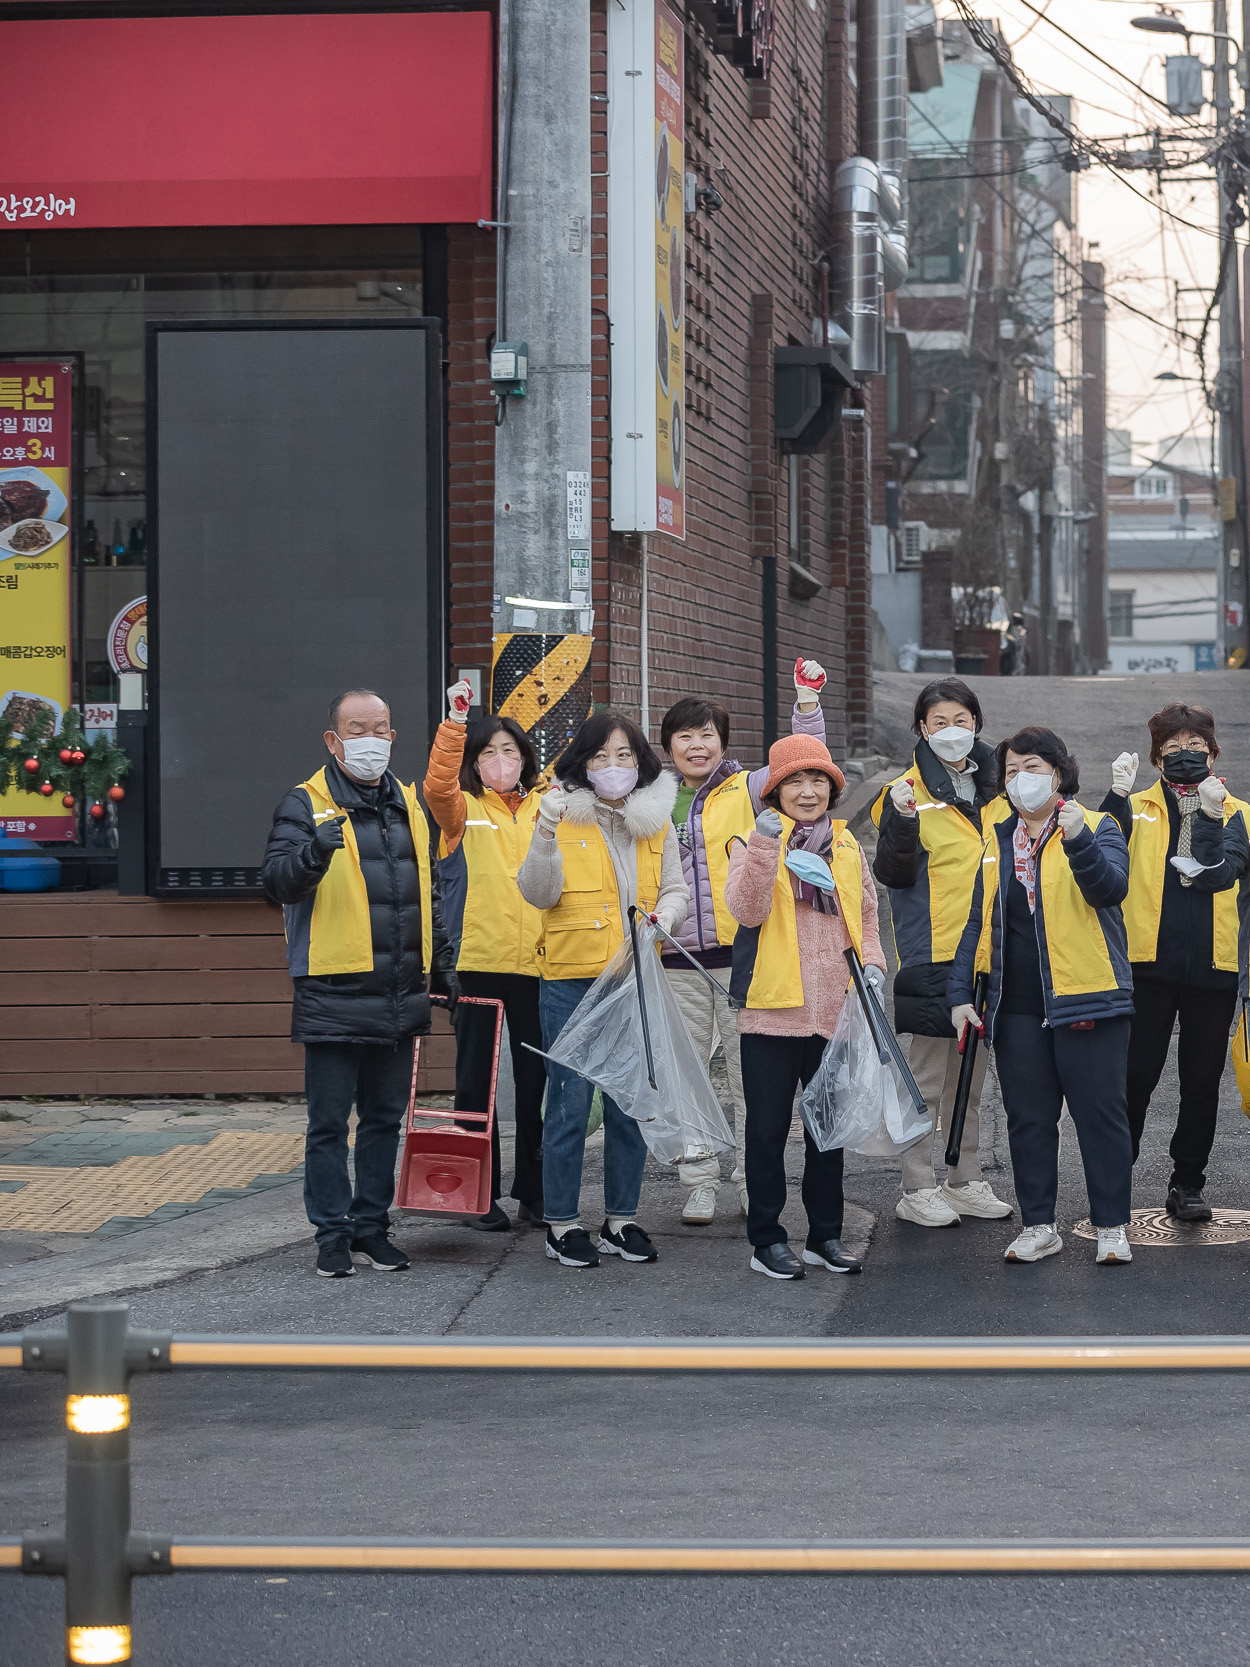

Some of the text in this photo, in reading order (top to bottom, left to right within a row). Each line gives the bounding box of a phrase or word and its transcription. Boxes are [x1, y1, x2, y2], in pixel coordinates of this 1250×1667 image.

[0, 376, 55, 411] 특선
[0, 417, 53, 434] 일 제외
